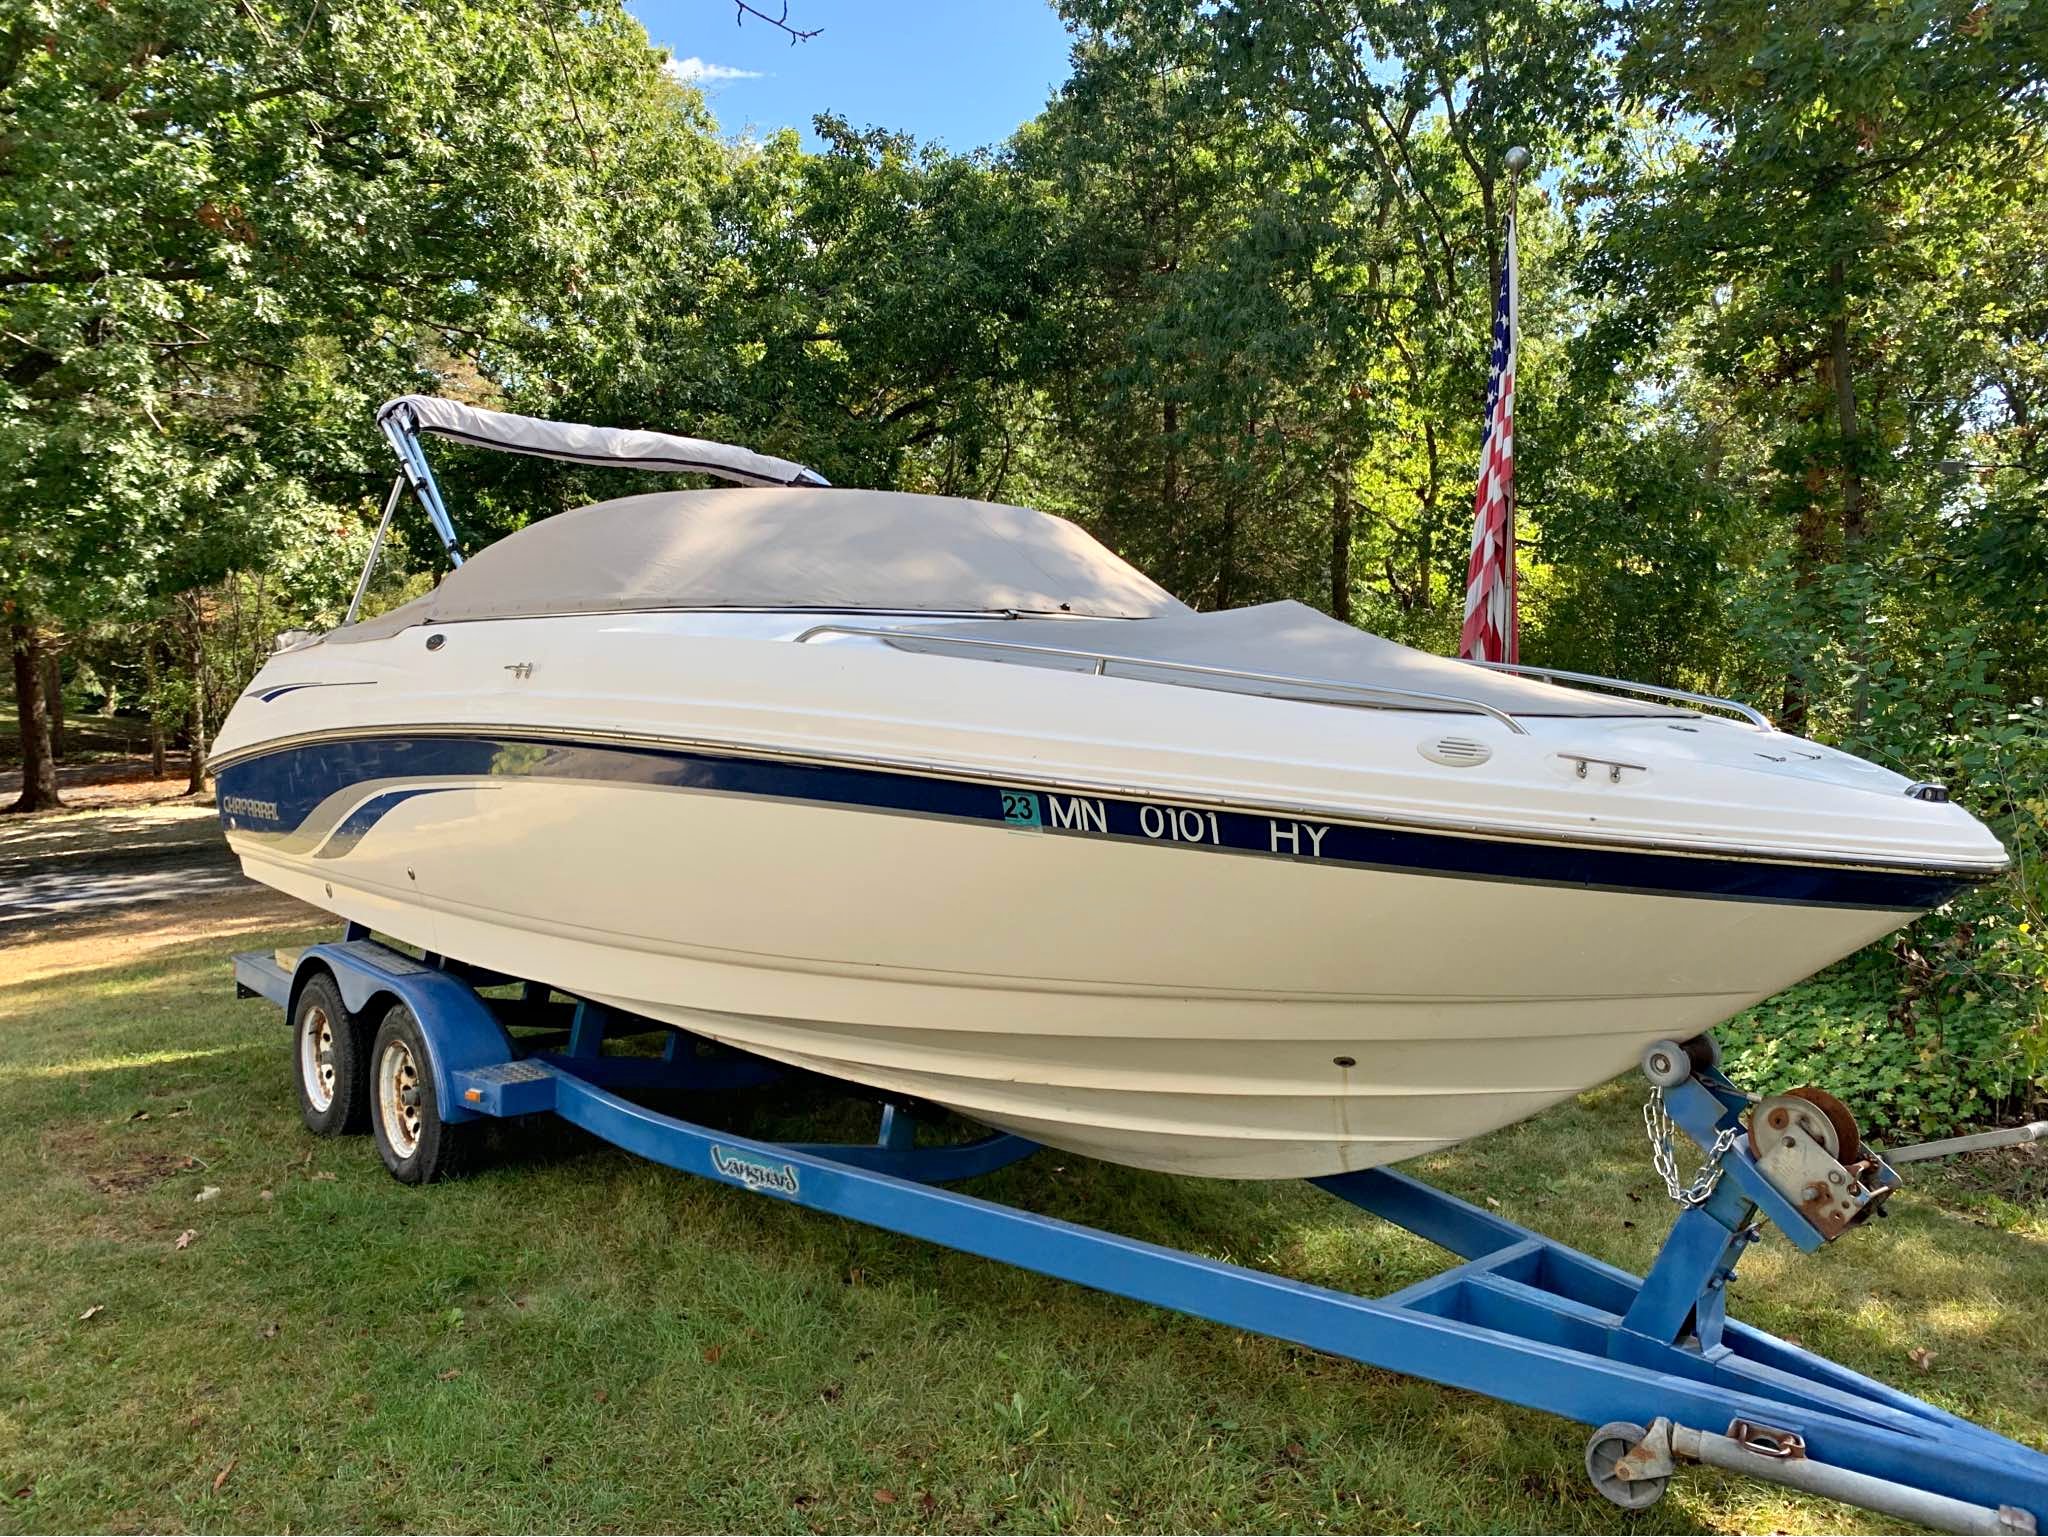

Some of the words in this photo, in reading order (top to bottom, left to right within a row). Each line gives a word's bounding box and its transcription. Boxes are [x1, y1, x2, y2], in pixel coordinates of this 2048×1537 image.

[223, 796, 280, 821] CHAPARRAL
[1003, 795, 1033, 820] 23
[1048, 794, 1108, 833] MN
[1140, 805, 1221, 845] 0101
[1270, 821, 1331, 857] HY
[711, 1144, 799, 1194] Vanguard
